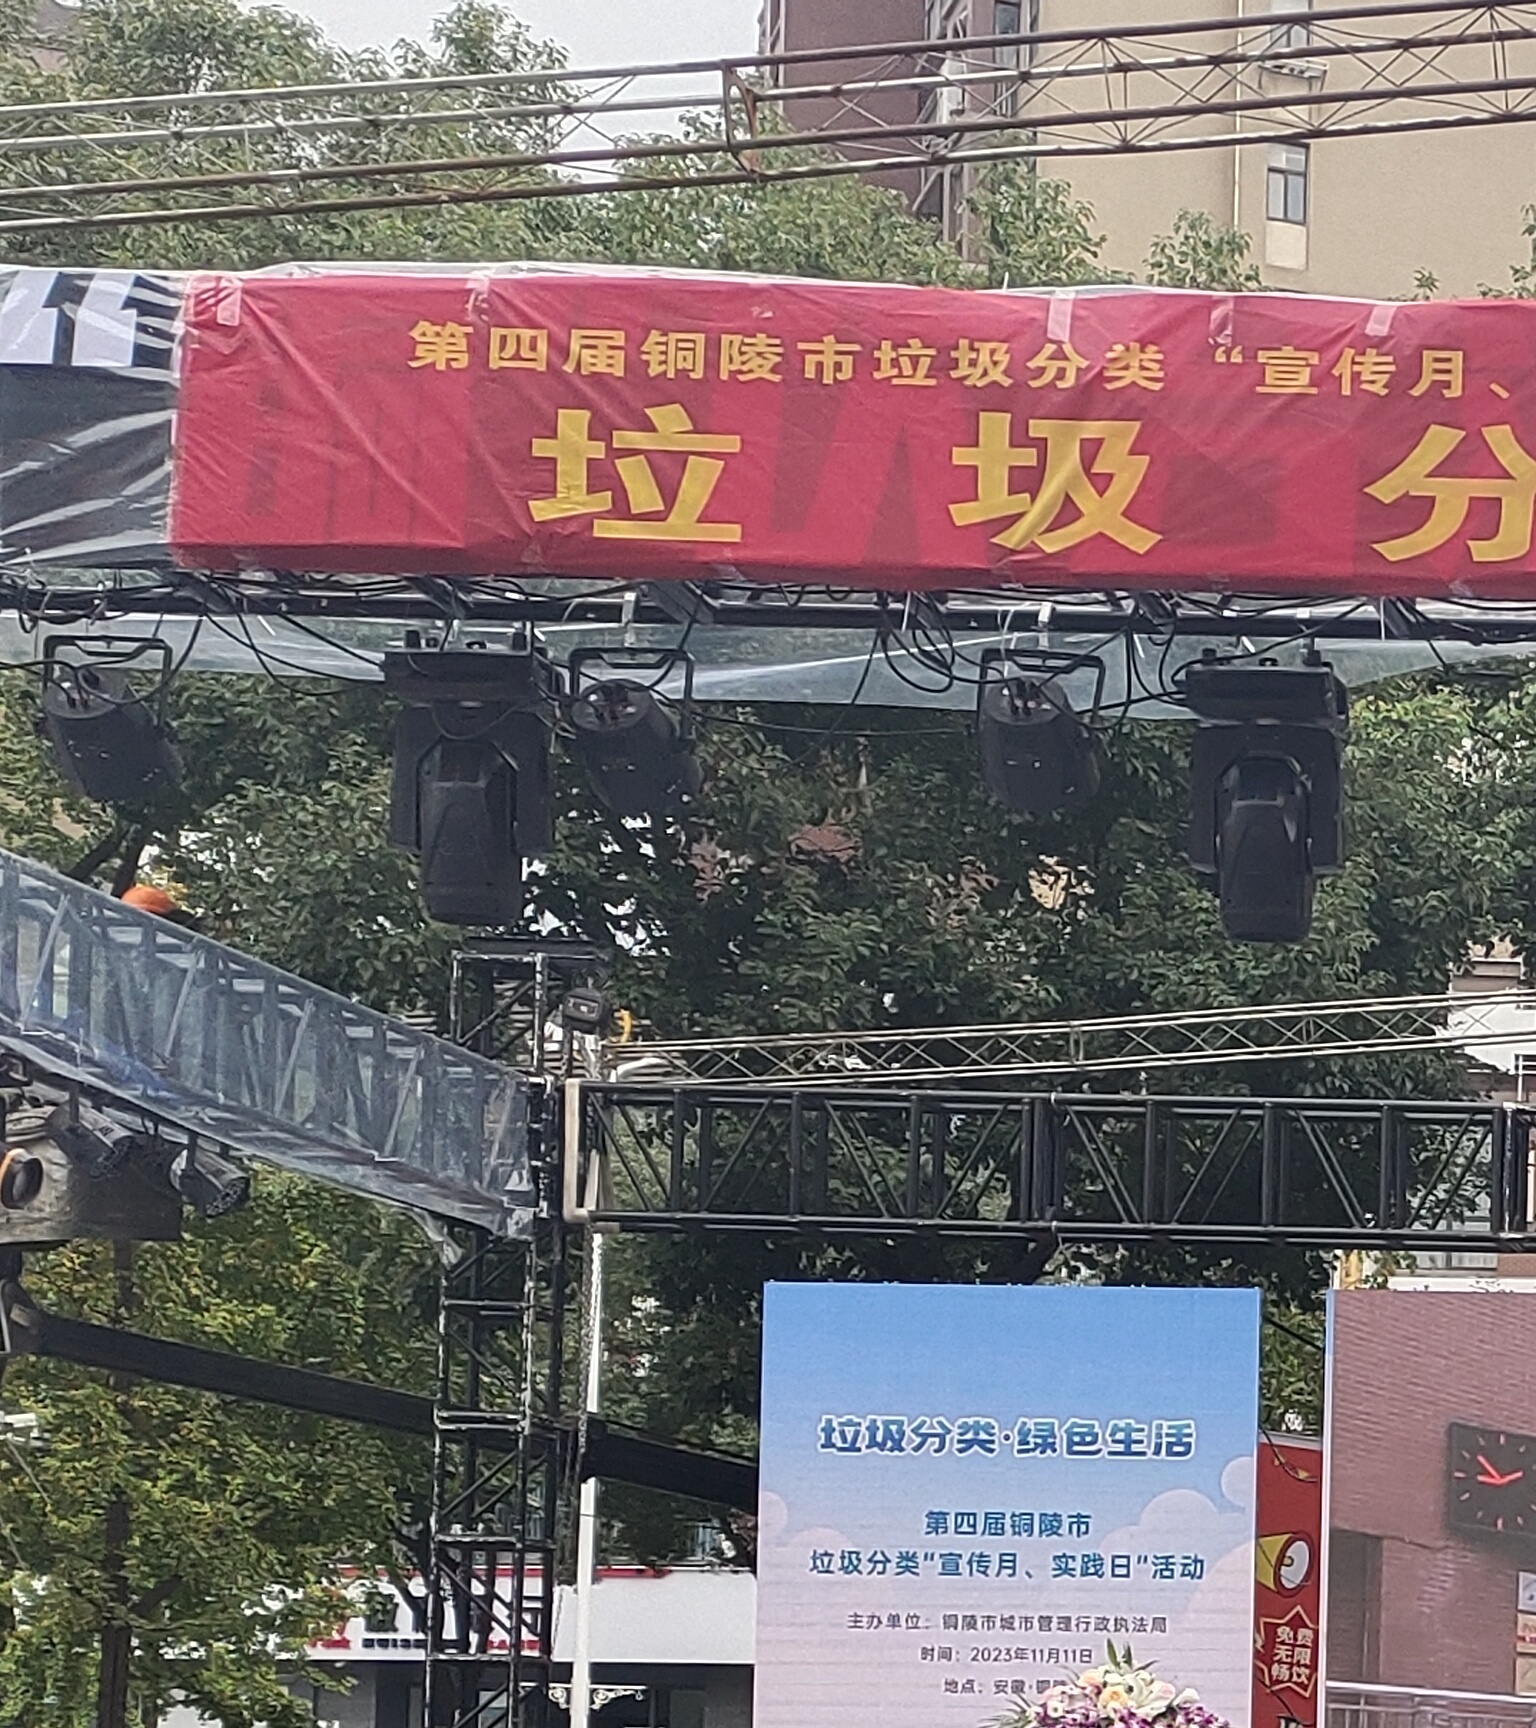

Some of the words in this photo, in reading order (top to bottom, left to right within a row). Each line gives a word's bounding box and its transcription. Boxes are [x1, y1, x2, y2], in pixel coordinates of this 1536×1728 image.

[817, 1415, 1198, 1459] 垃圾分类·绿色生活
[925, 1510, 1093, 1538] 第四届铜陵市
[920, 1646, 1093, 1665] 时间：2023年11月11日
